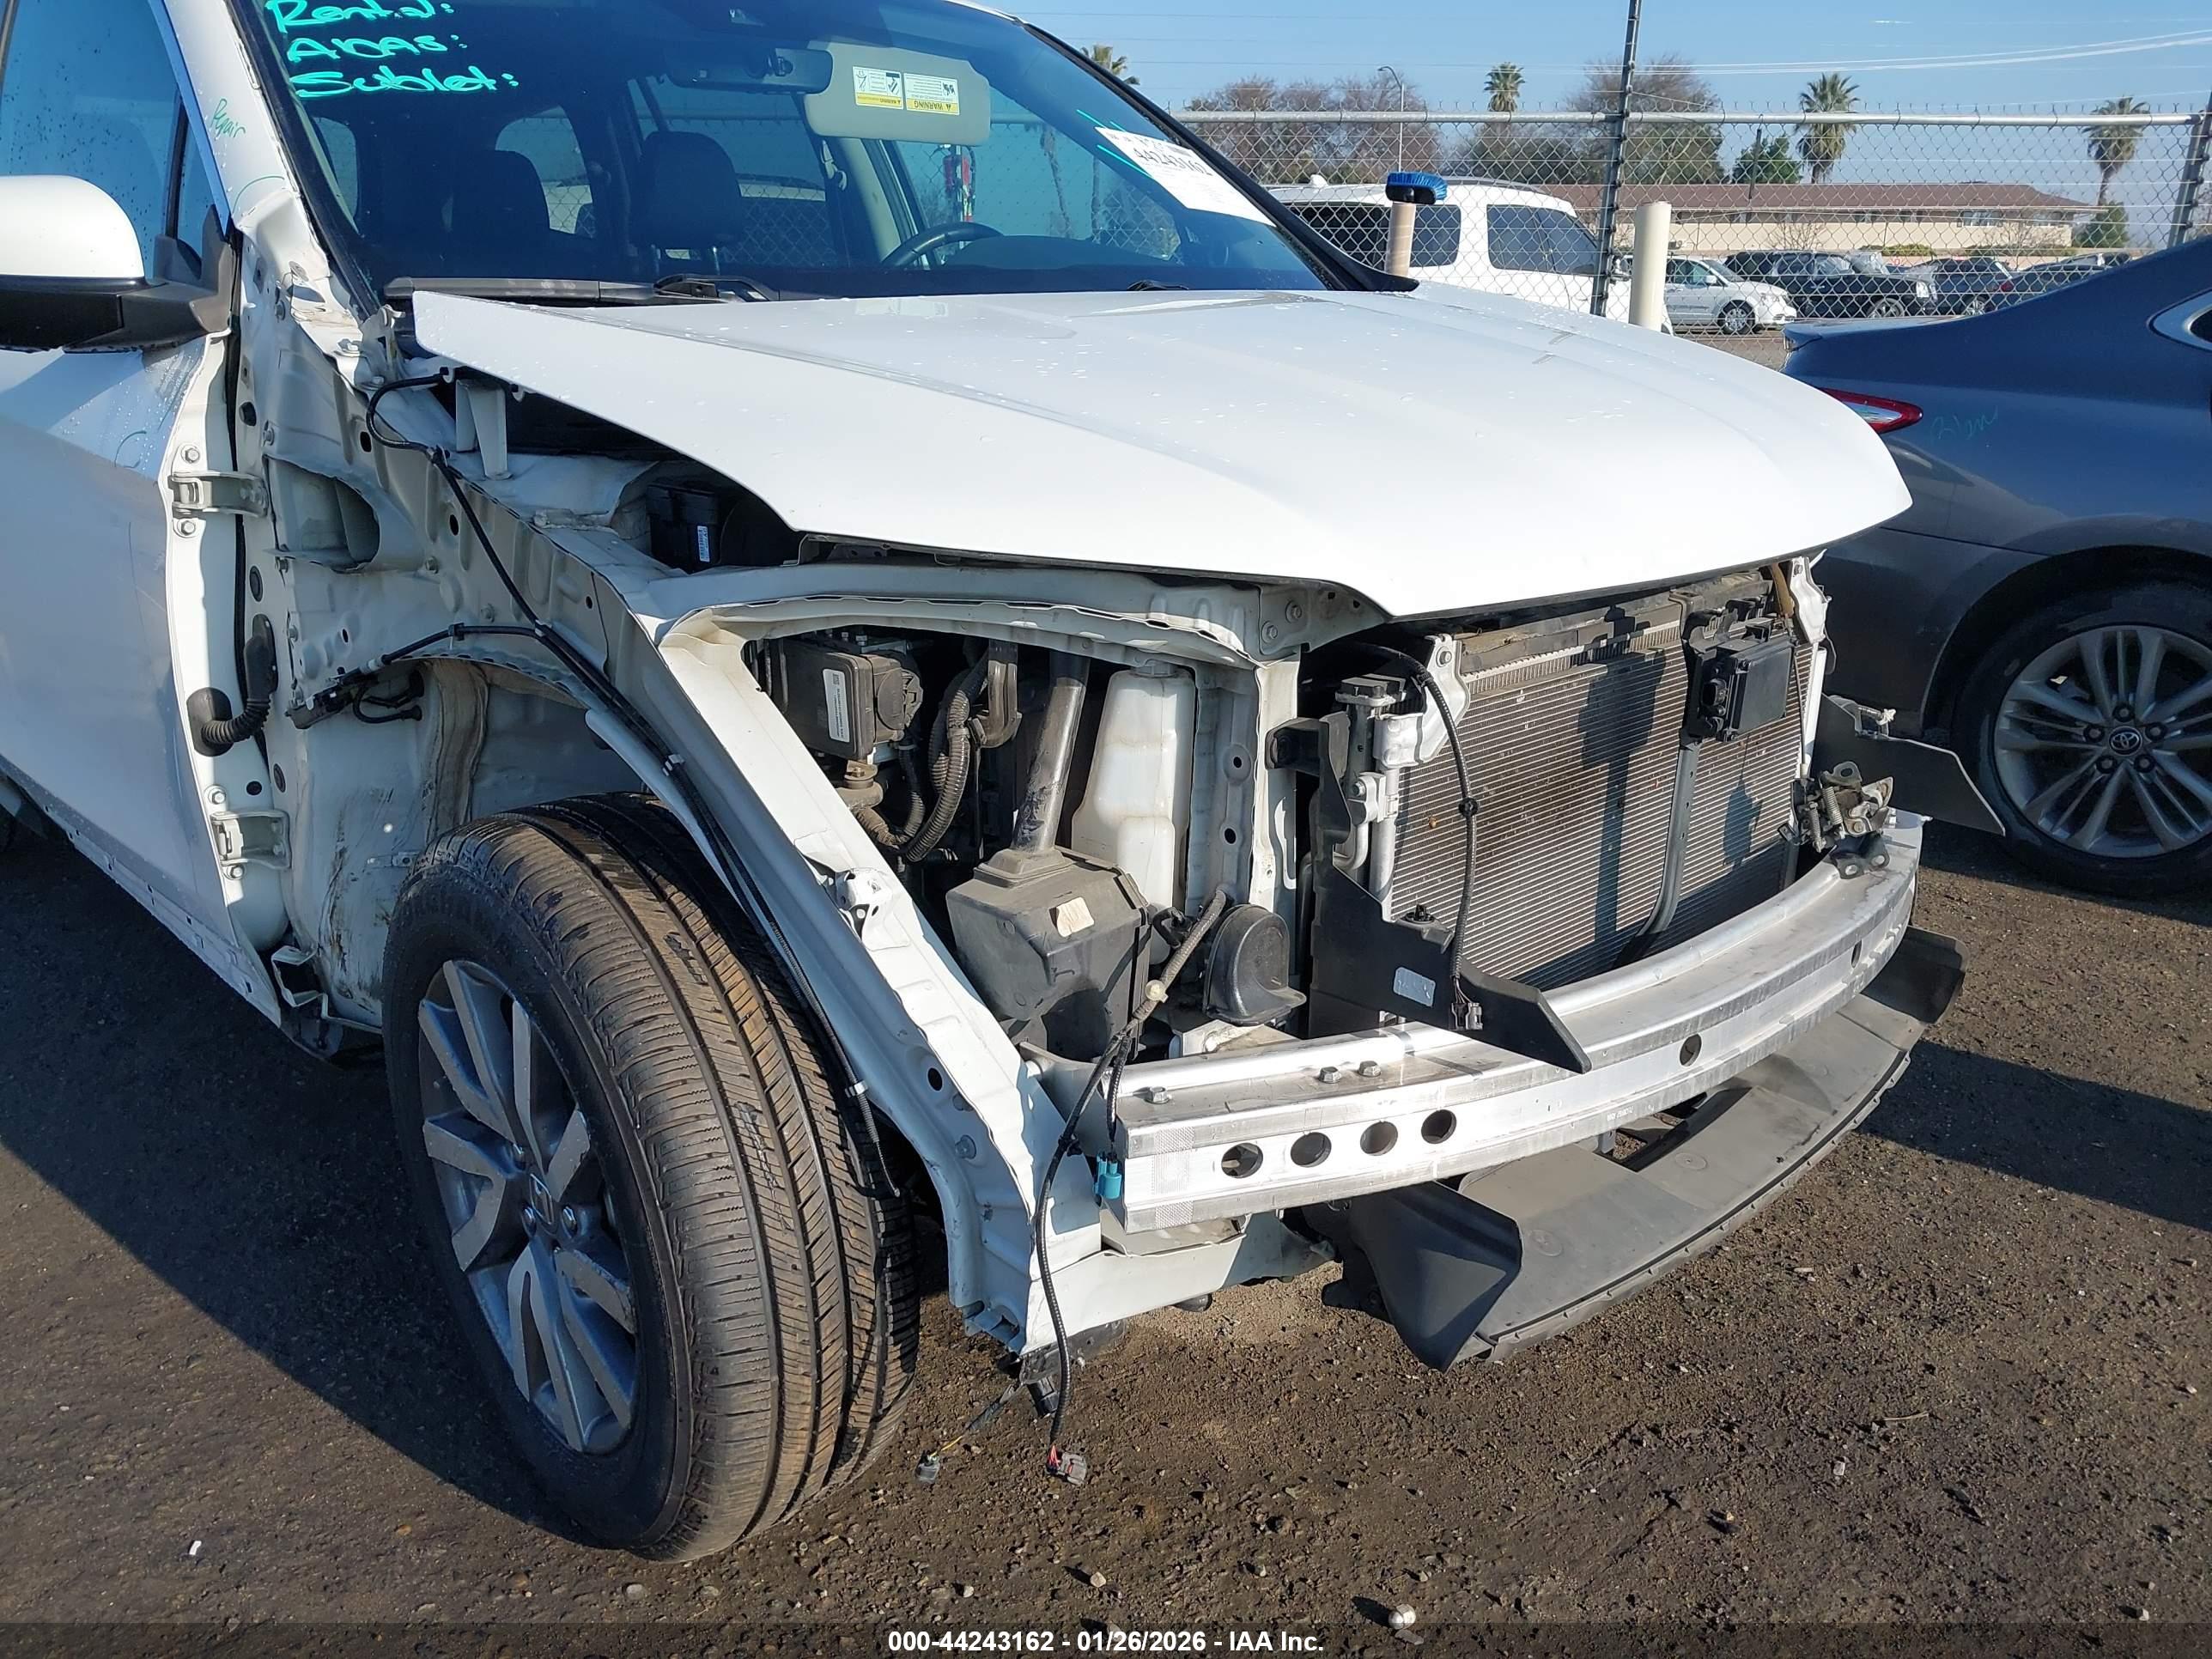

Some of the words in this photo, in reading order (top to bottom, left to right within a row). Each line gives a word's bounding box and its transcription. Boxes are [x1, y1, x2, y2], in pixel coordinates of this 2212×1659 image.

[289, 65, 519, 98] Sublet:
[914, 100, 944, 111] WARNING
[1133, 147, 1213, 177] 44243162
